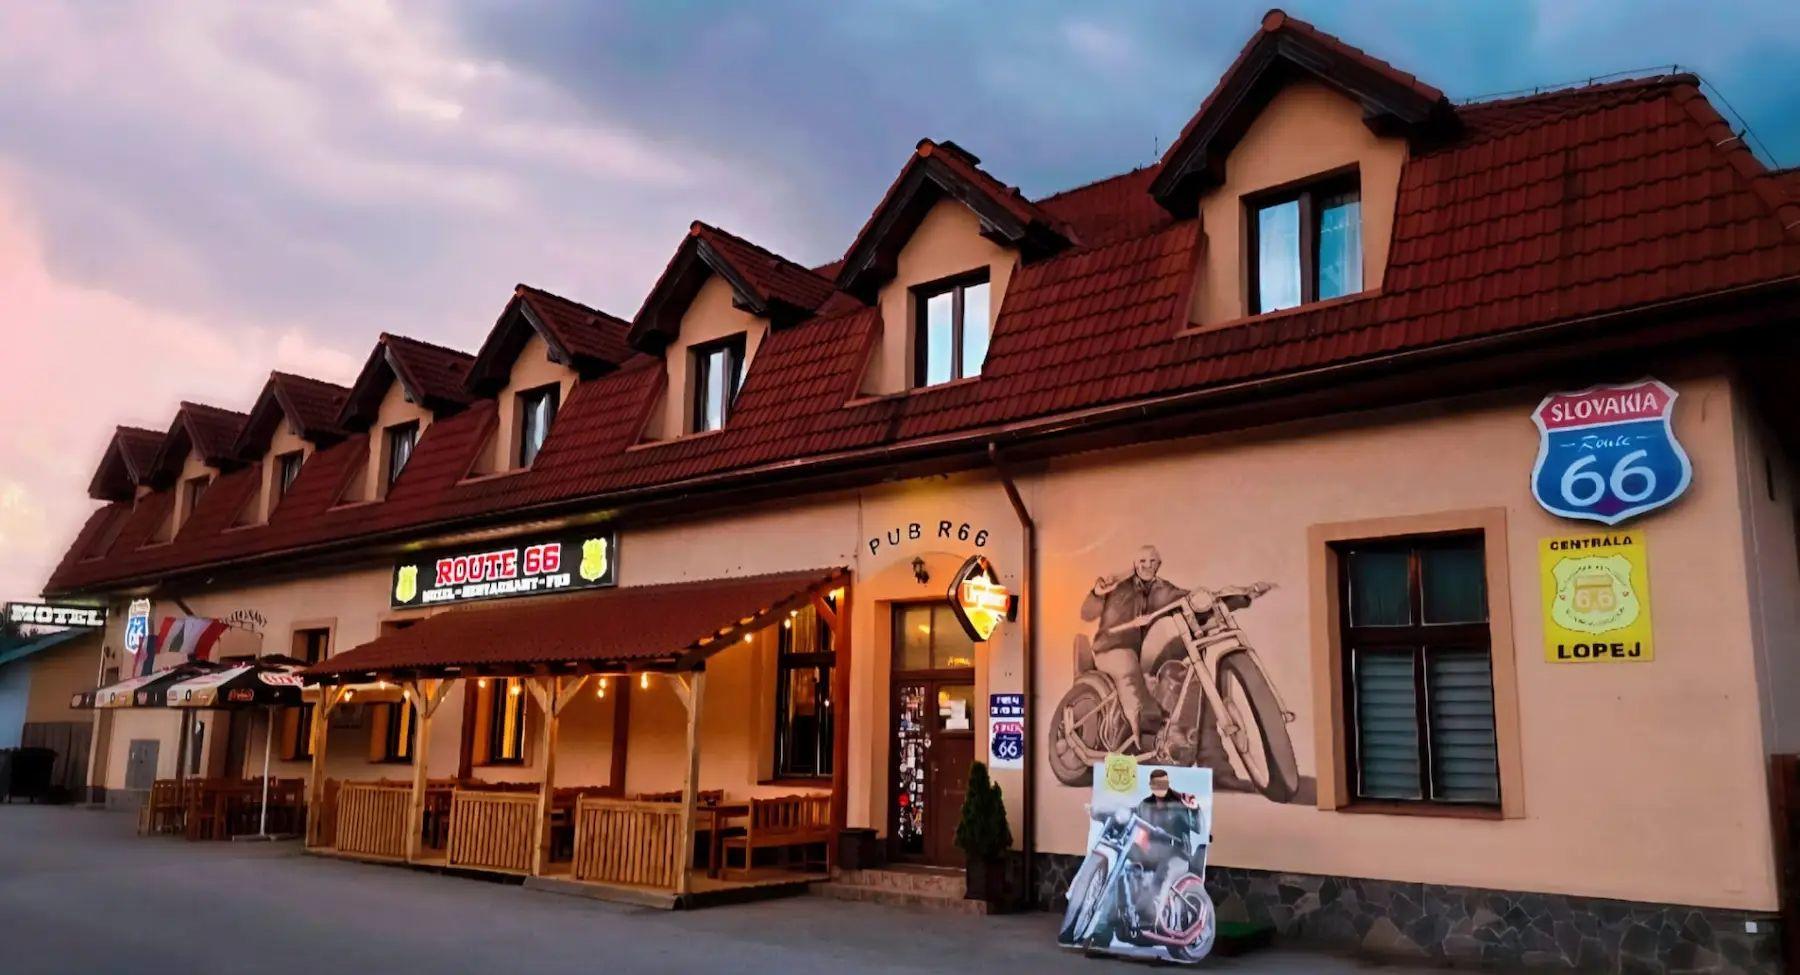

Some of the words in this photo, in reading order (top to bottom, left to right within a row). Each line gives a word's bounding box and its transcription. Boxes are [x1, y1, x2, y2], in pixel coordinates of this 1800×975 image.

[1551, 392, 1659, 423] SLOVAKIA
[1579, 434, 1631, 452] Route
[1560, 449, 1657, 507] 66
[868, 523, 922, 555] PUB
[938, 520, 989, 547] R66
[1550, 535, 1633, 551] CENTRALA
[435, 548, 518, 587] ROUTE
[523, 542, 561, 576] 66
[10, 604, 104, 626] MOTEL
[1557, 641, 1641, 659] LOPEJ
[998, 741, 1018, 757] 66
